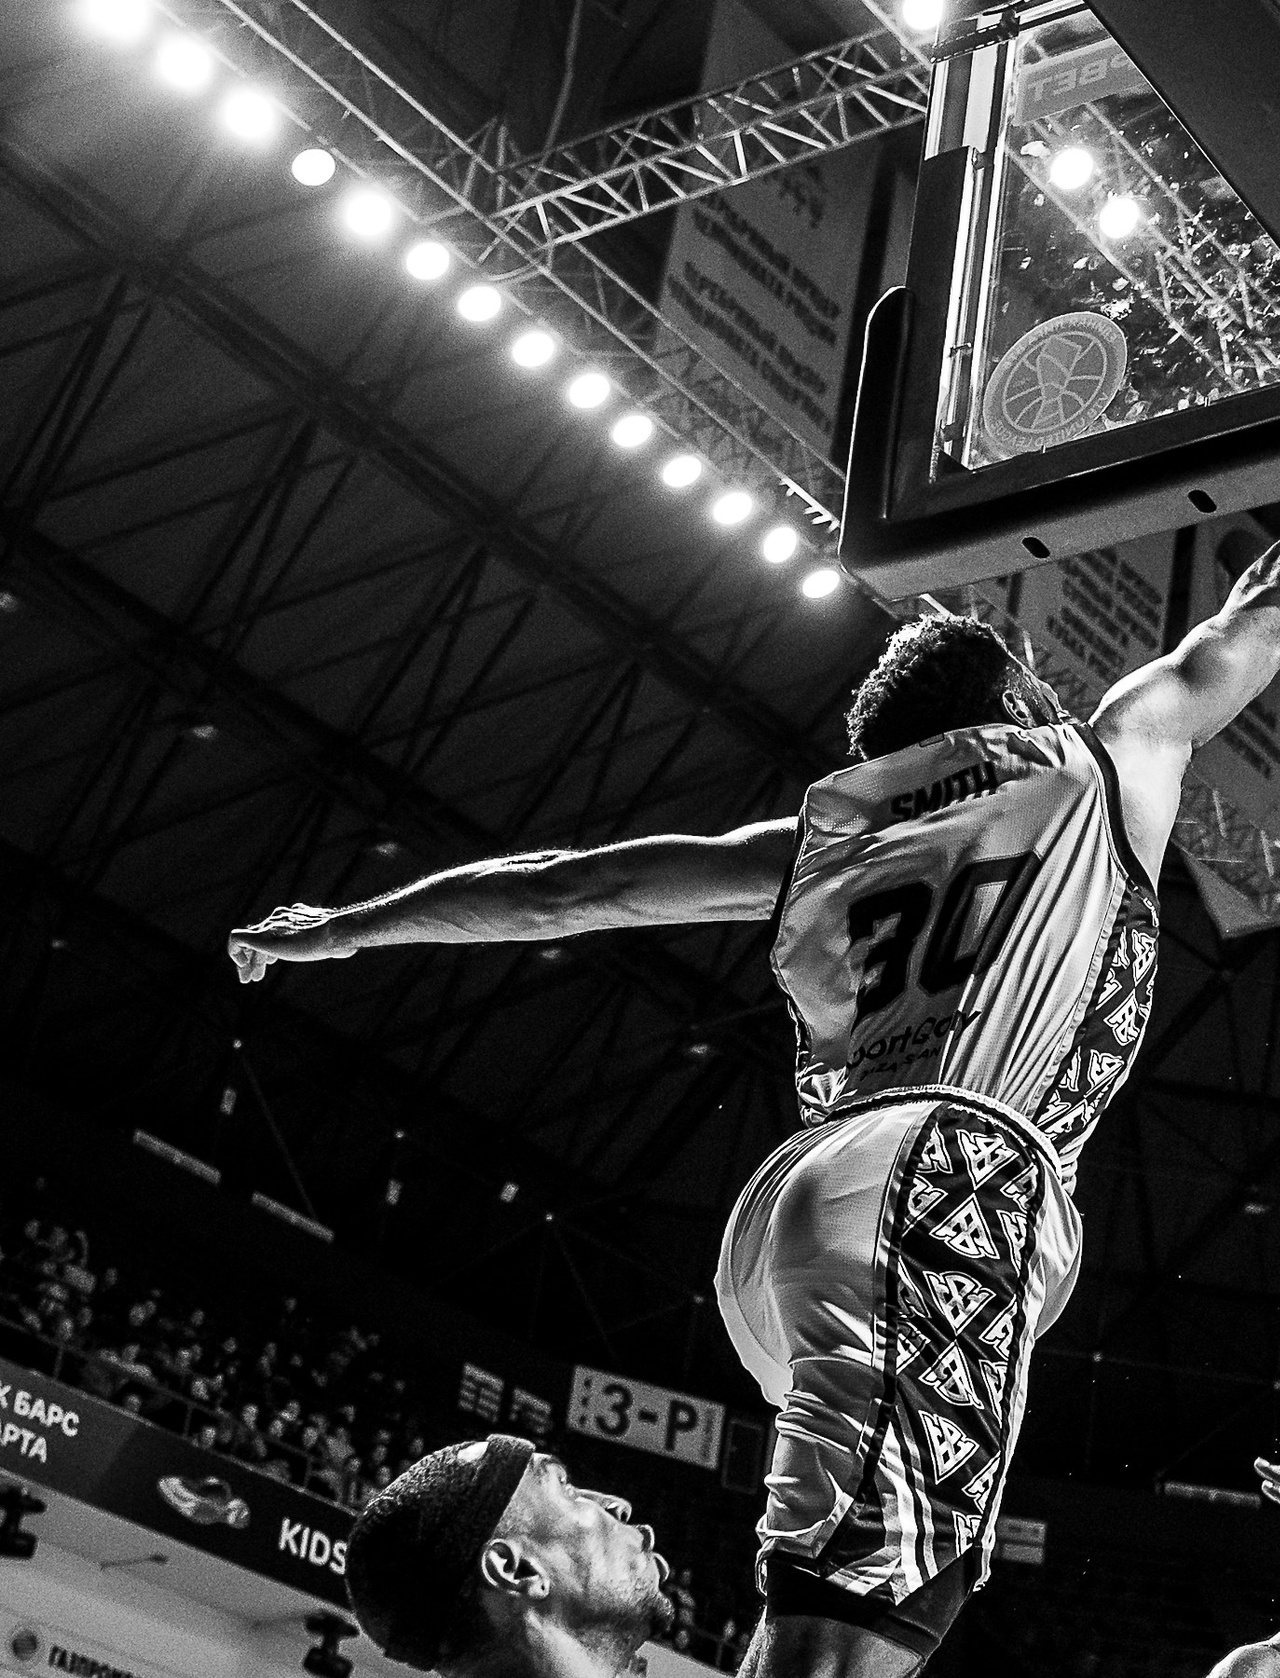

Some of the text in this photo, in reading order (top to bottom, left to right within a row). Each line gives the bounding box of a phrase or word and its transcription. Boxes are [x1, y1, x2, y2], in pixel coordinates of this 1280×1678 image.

[891, 760, 997, 821] SMITH
[847, 850, 1039, 1015] 30
[0, 1418, 47, 1464] РТА
[14, 1390, 80, 1438] БАРС
[596, 1383, 700, 1451] 3-Р
[279, 1516, 348, 1575] KIDS
